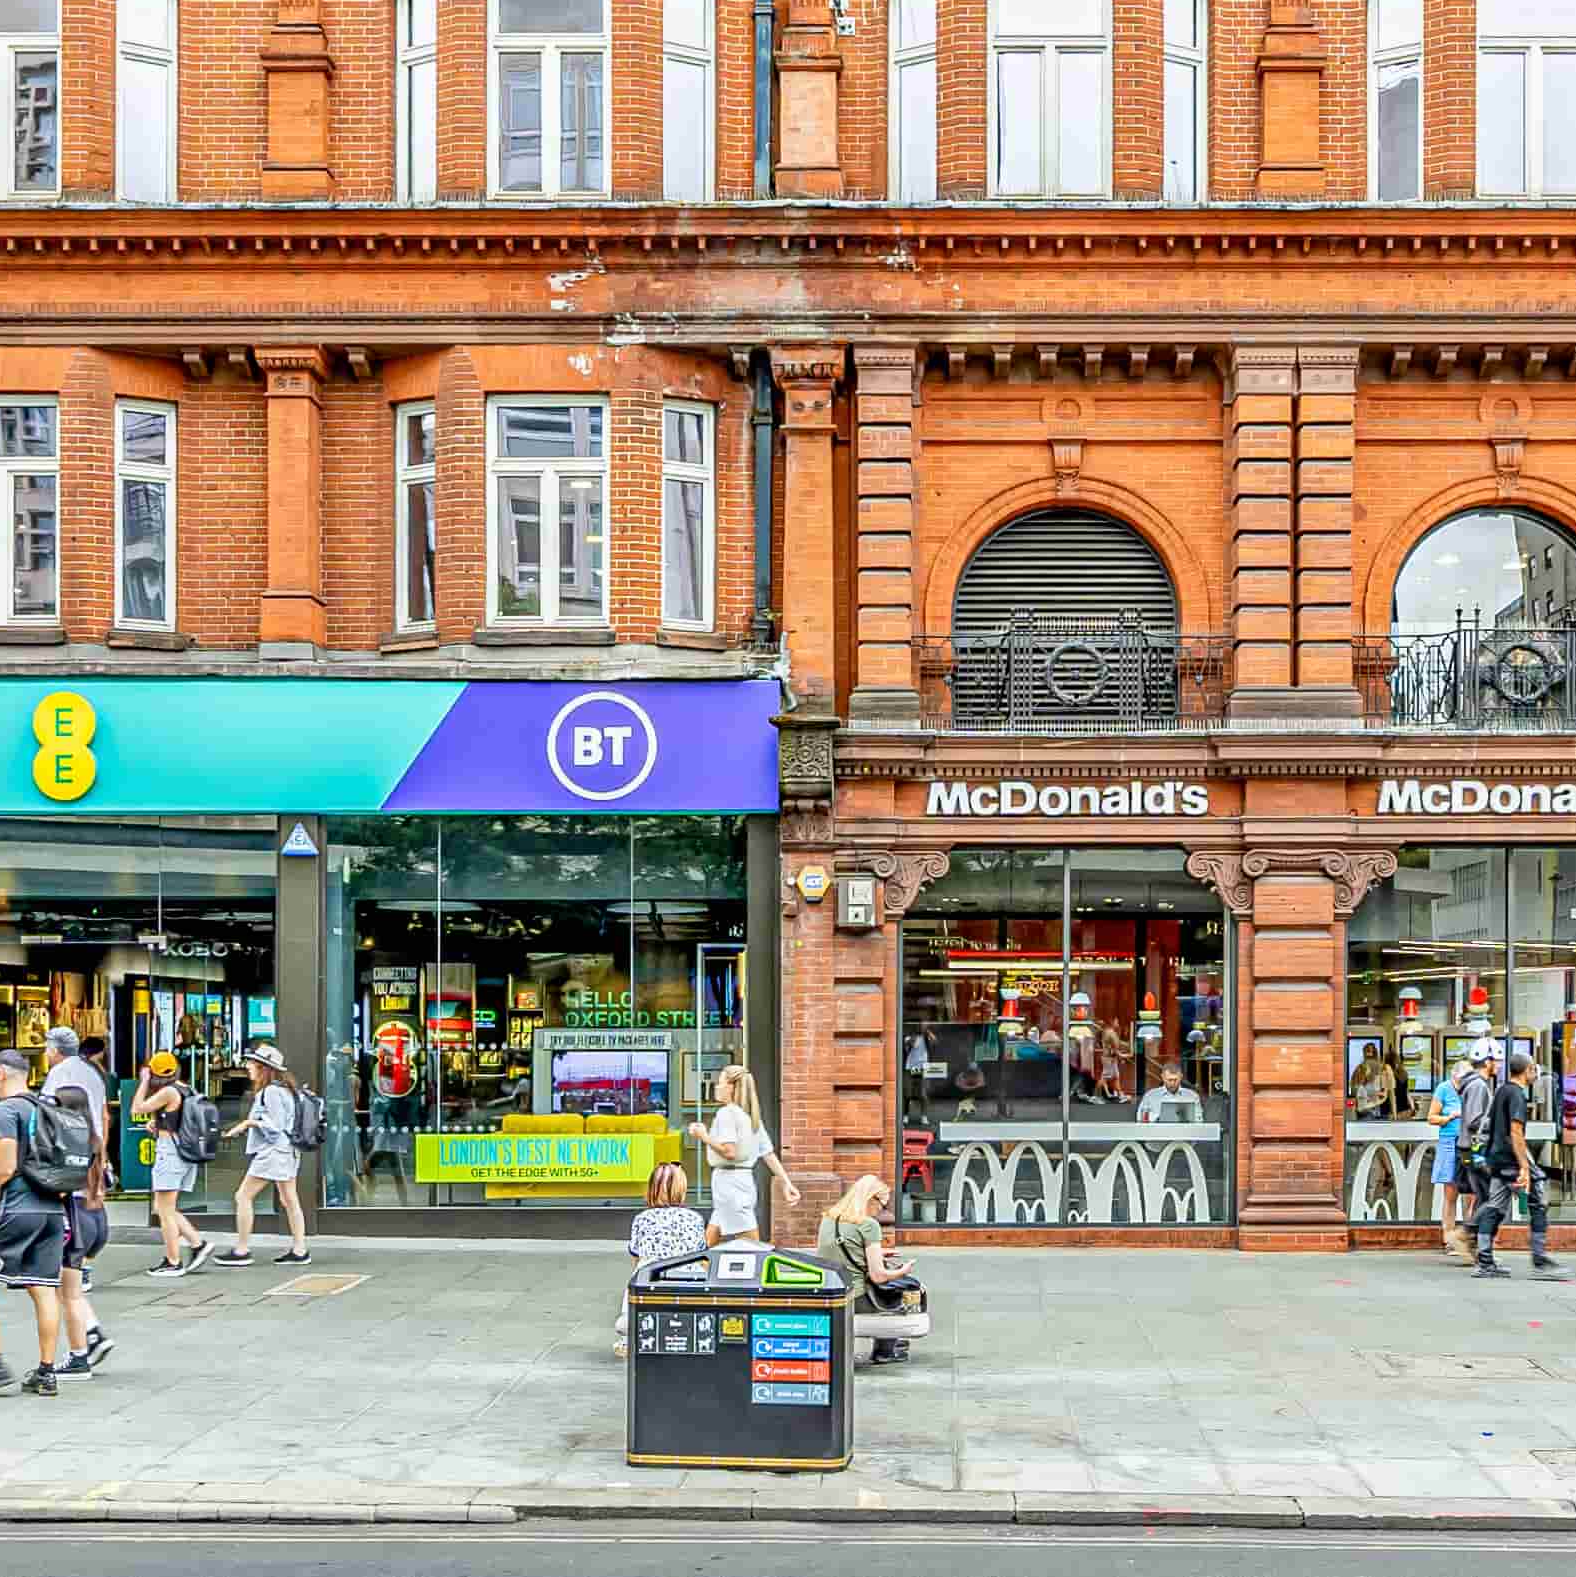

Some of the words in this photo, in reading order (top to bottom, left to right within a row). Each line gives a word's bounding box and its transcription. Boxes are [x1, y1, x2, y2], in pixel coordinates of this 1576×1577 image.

[574, 726, 632, 765] BT
[926, 780, 1209, 816] McDonald's
[565, 1011, 650, 1027] OXFORD
[438, 1138, 512, 1166] LONDON'S
[517, 1138, 551, 1166] BEST
[558, 1138, 631, 1166] NETWORK
[471, 1167, 493, 1178] GET
[495, 1167, 516, 1178] THE
[518, 1167, 548, 1178] EDGE
[549, 1167, 578, 1178] WITH
